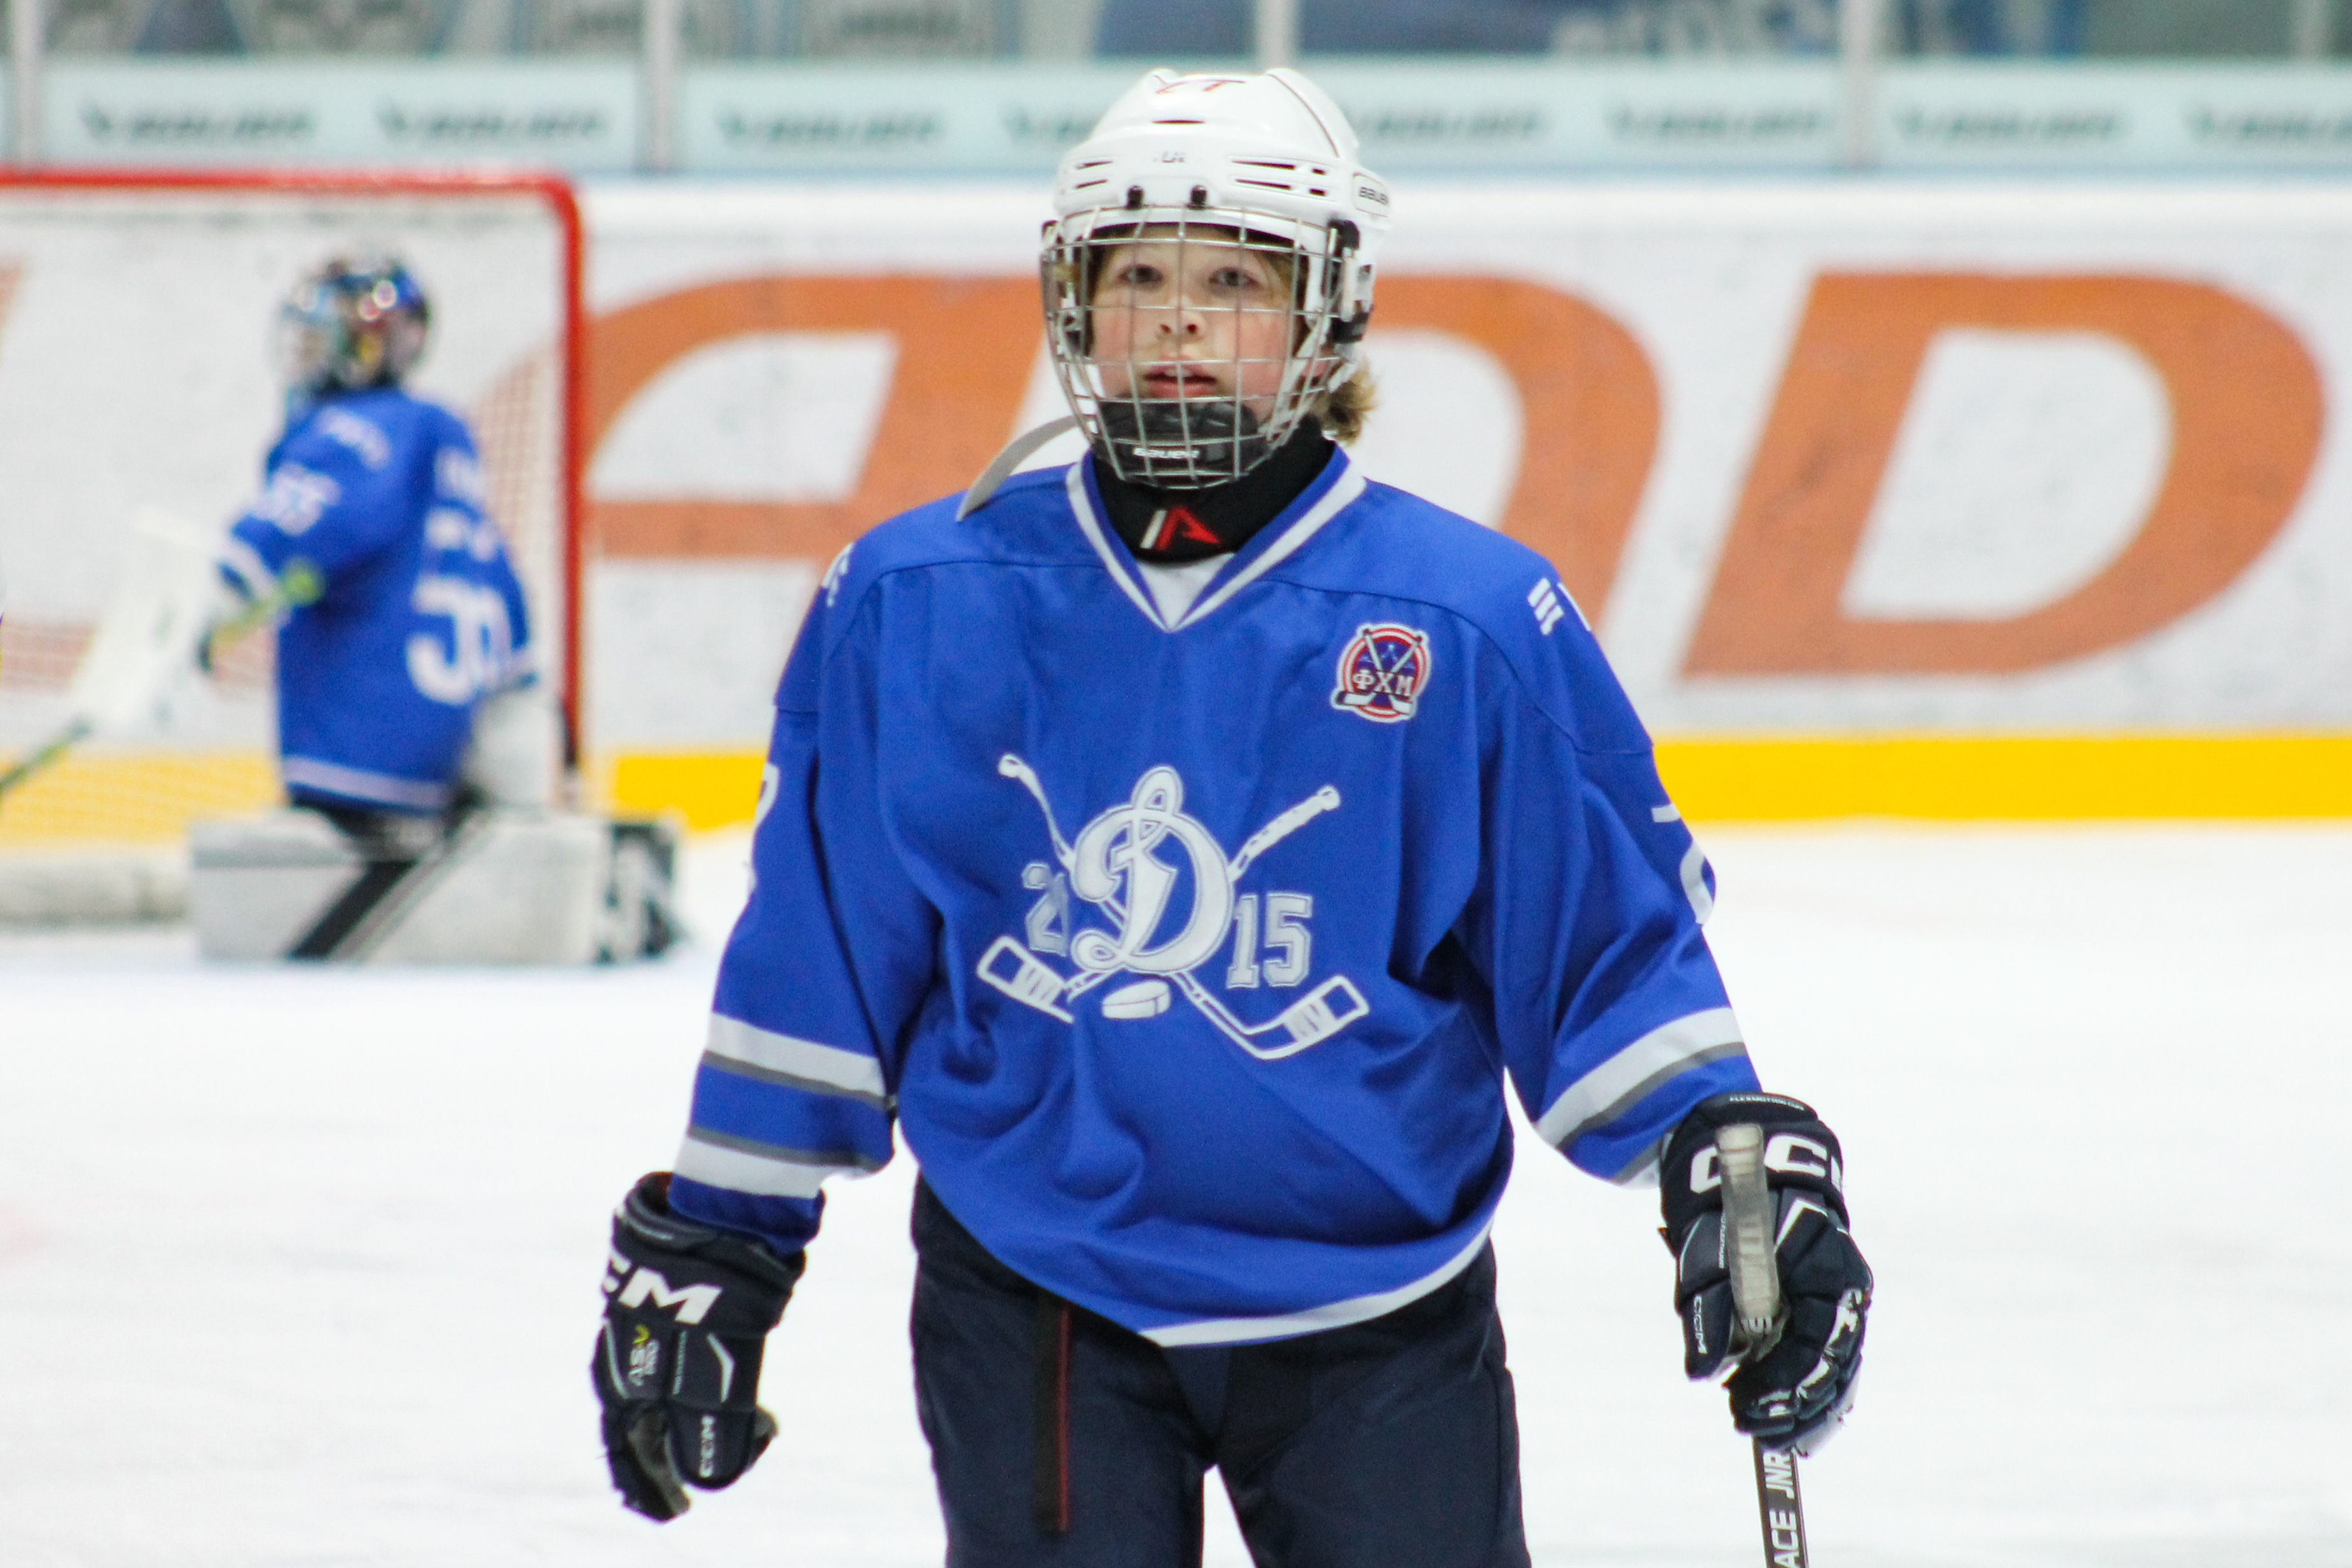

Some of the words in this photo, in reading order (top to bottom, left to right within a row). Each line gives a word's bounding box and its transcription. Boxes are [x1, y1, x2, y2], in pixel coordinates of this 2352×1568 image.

[1359, 186, 1390, 205] BAUE
[1225, 891, 1312, 989] 15
[1689, 1132, 1842, 1194] CC
[1693, 1293, 1708, 1354] CCM
[1763, 1452, 1795, 1499] JNR
